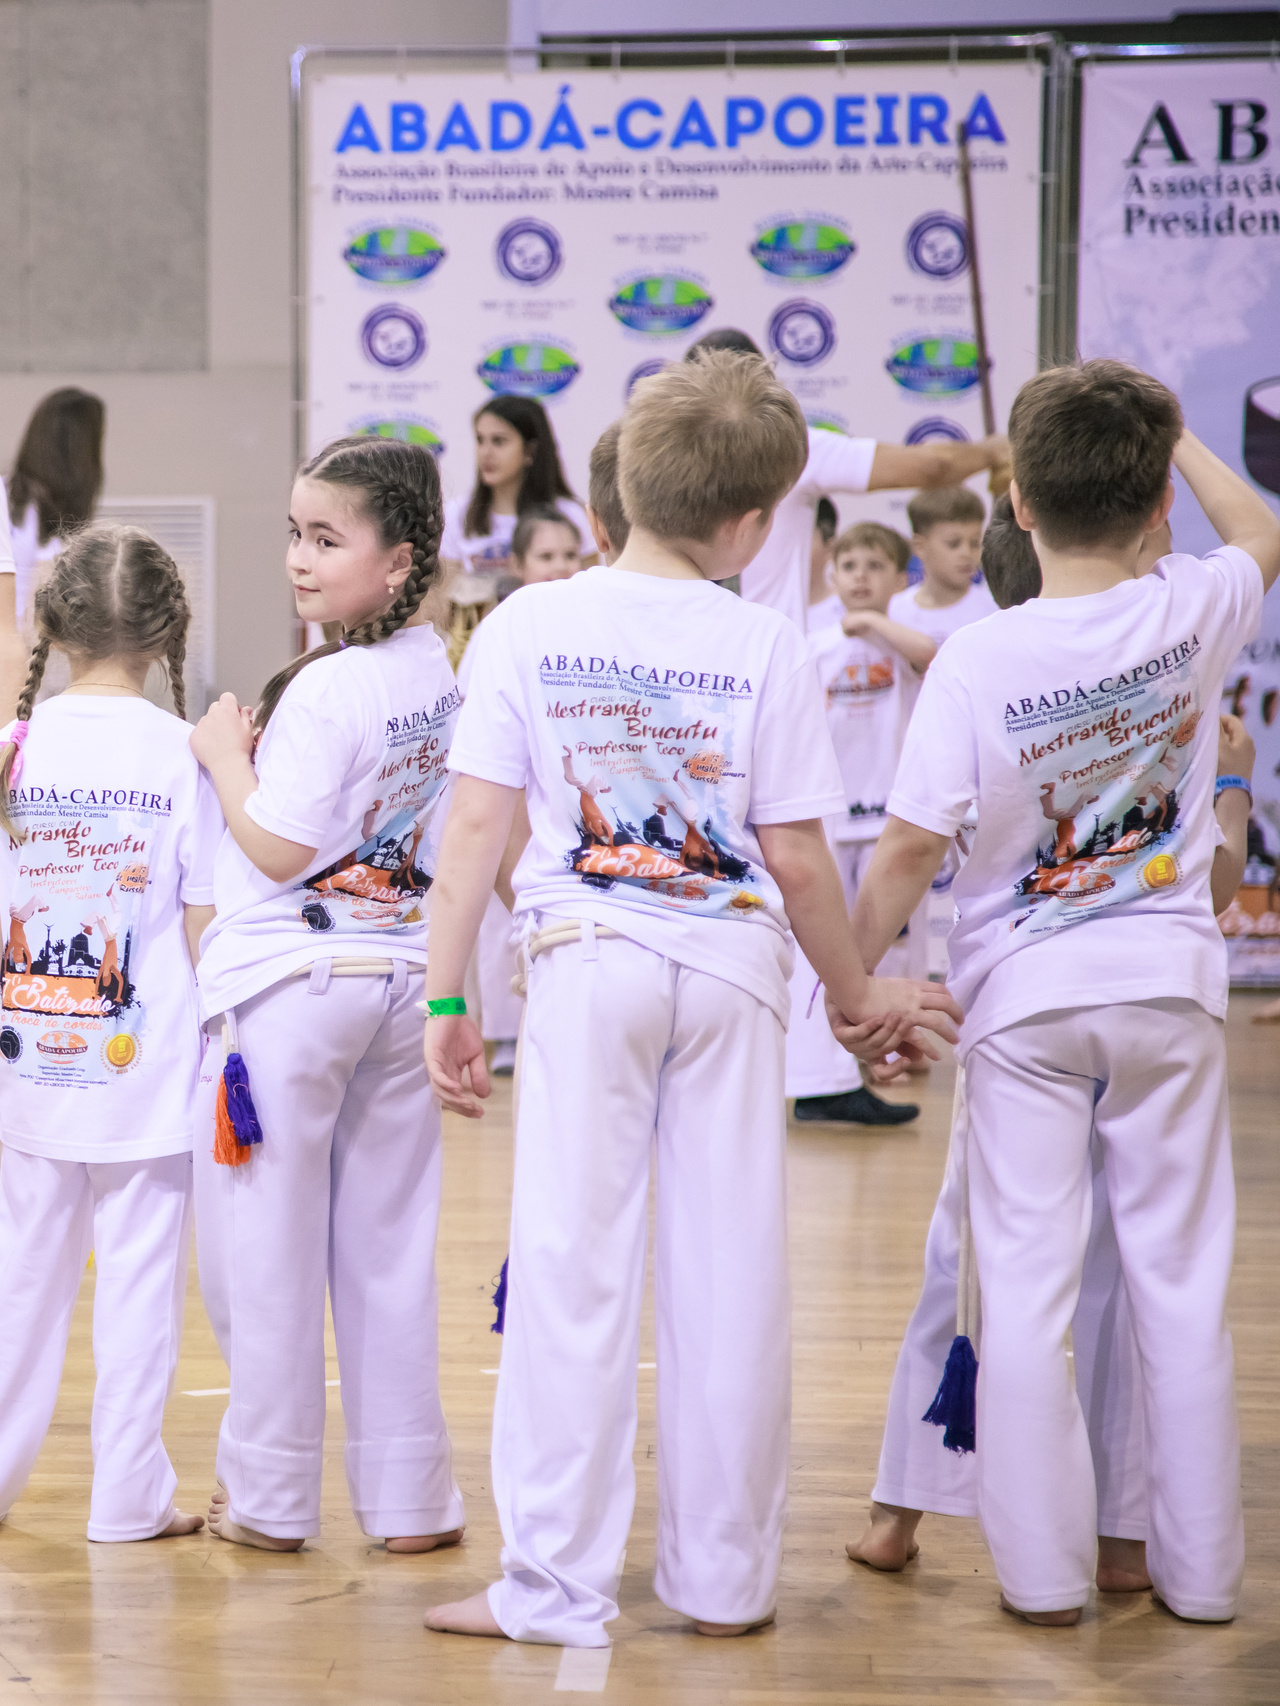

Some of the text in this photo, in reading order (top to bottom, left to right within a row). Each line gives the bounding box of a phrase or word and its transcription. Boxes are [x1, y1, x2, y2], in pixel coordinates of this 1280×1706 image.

[335, 84, 1007, 153] ABADÁ-CAPOEIRA
[870, 152, 1008, 178] Arte-Capeira
[540, 654, 753, 693] ABADÁ-CAPOEIRA
[1004, 633, 1200, 719] ABADÁ-CAPOEIRA
[540, 677, 671, 700] Presidente Fundador: Mestre Camisa
[640, 681, 696, 694] Desenvolvimento
[547, 699, 652, 718] Mestrando
[1006, 688, 1146, 734] Presidente Fundador: Mestre Camisa
[1043, 705, 1074, 716] Brasileira
[1104, 691, 1191, 747] Brucutu
[623, 716, 718, 740] Brucutu
[1019, 707, 1131, 767] Mestrando
[575, 740, 685, 756] Professor Teco
[1059, 726, 1174, 783] Professor Teco
[9, 784, 172, 811] BADÁ-CAPOEIRA
[64, 834, 145, 858] Brucutu
[19, 858, 119, 877] Professor Teco
[11, 977, 116, 1014] Batizado
[11, 1010, 40, 1026] troca
[45, 1018, 58, 1028] de
